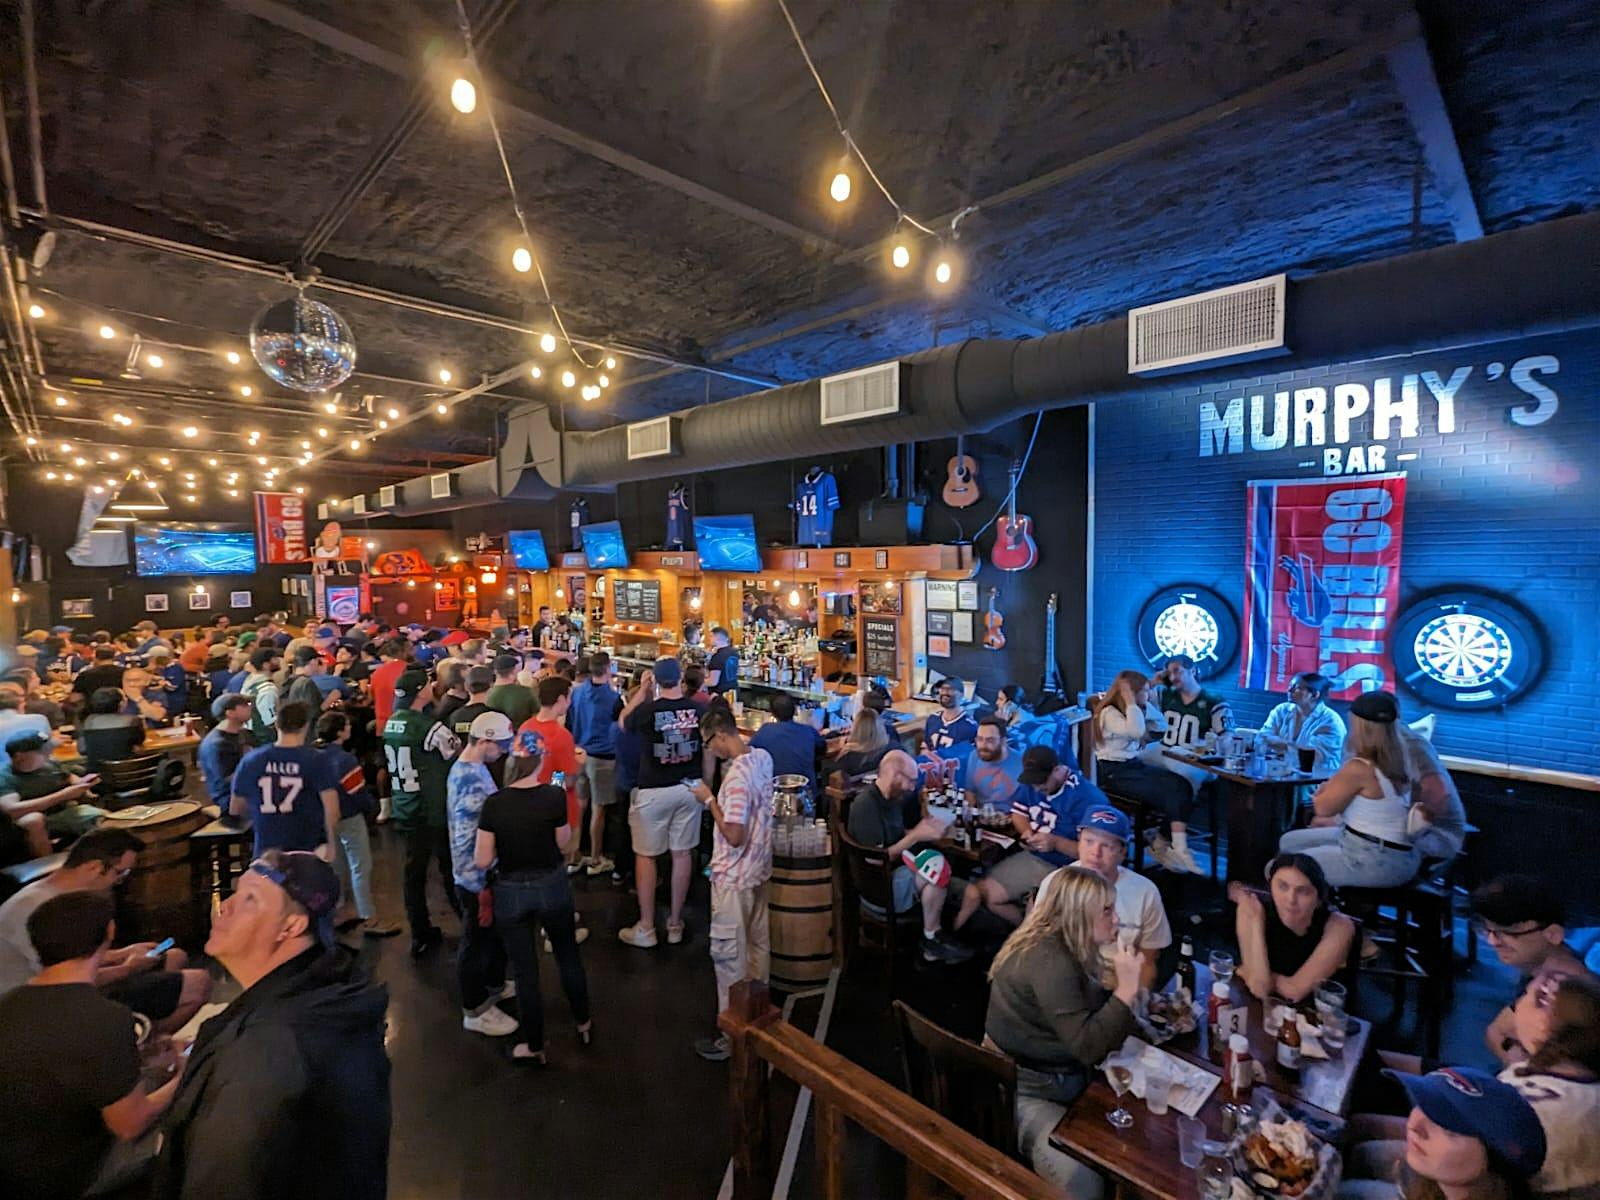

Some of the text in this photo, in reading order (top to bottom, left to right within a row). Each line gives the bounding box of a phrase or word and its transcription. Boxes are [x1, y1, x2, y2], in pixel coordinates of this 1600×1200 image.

[1199, 355, 1561, 457] MURPHY'S
[1323, 445, 1387, 476] BAR
[801, 494, 817, 516] 14
[928, 583, 957, 592] WARNING
[1317, 488, 1392, 693] GO BILLS
[867, 622, 894, 632] SPECIALS
[1163, 710, 1200, 747] 80
[265, 761, 300, 774] ALLEN
[258, 775, 304, 814] 17
[1230, 1014, 1240, 1034] 3
